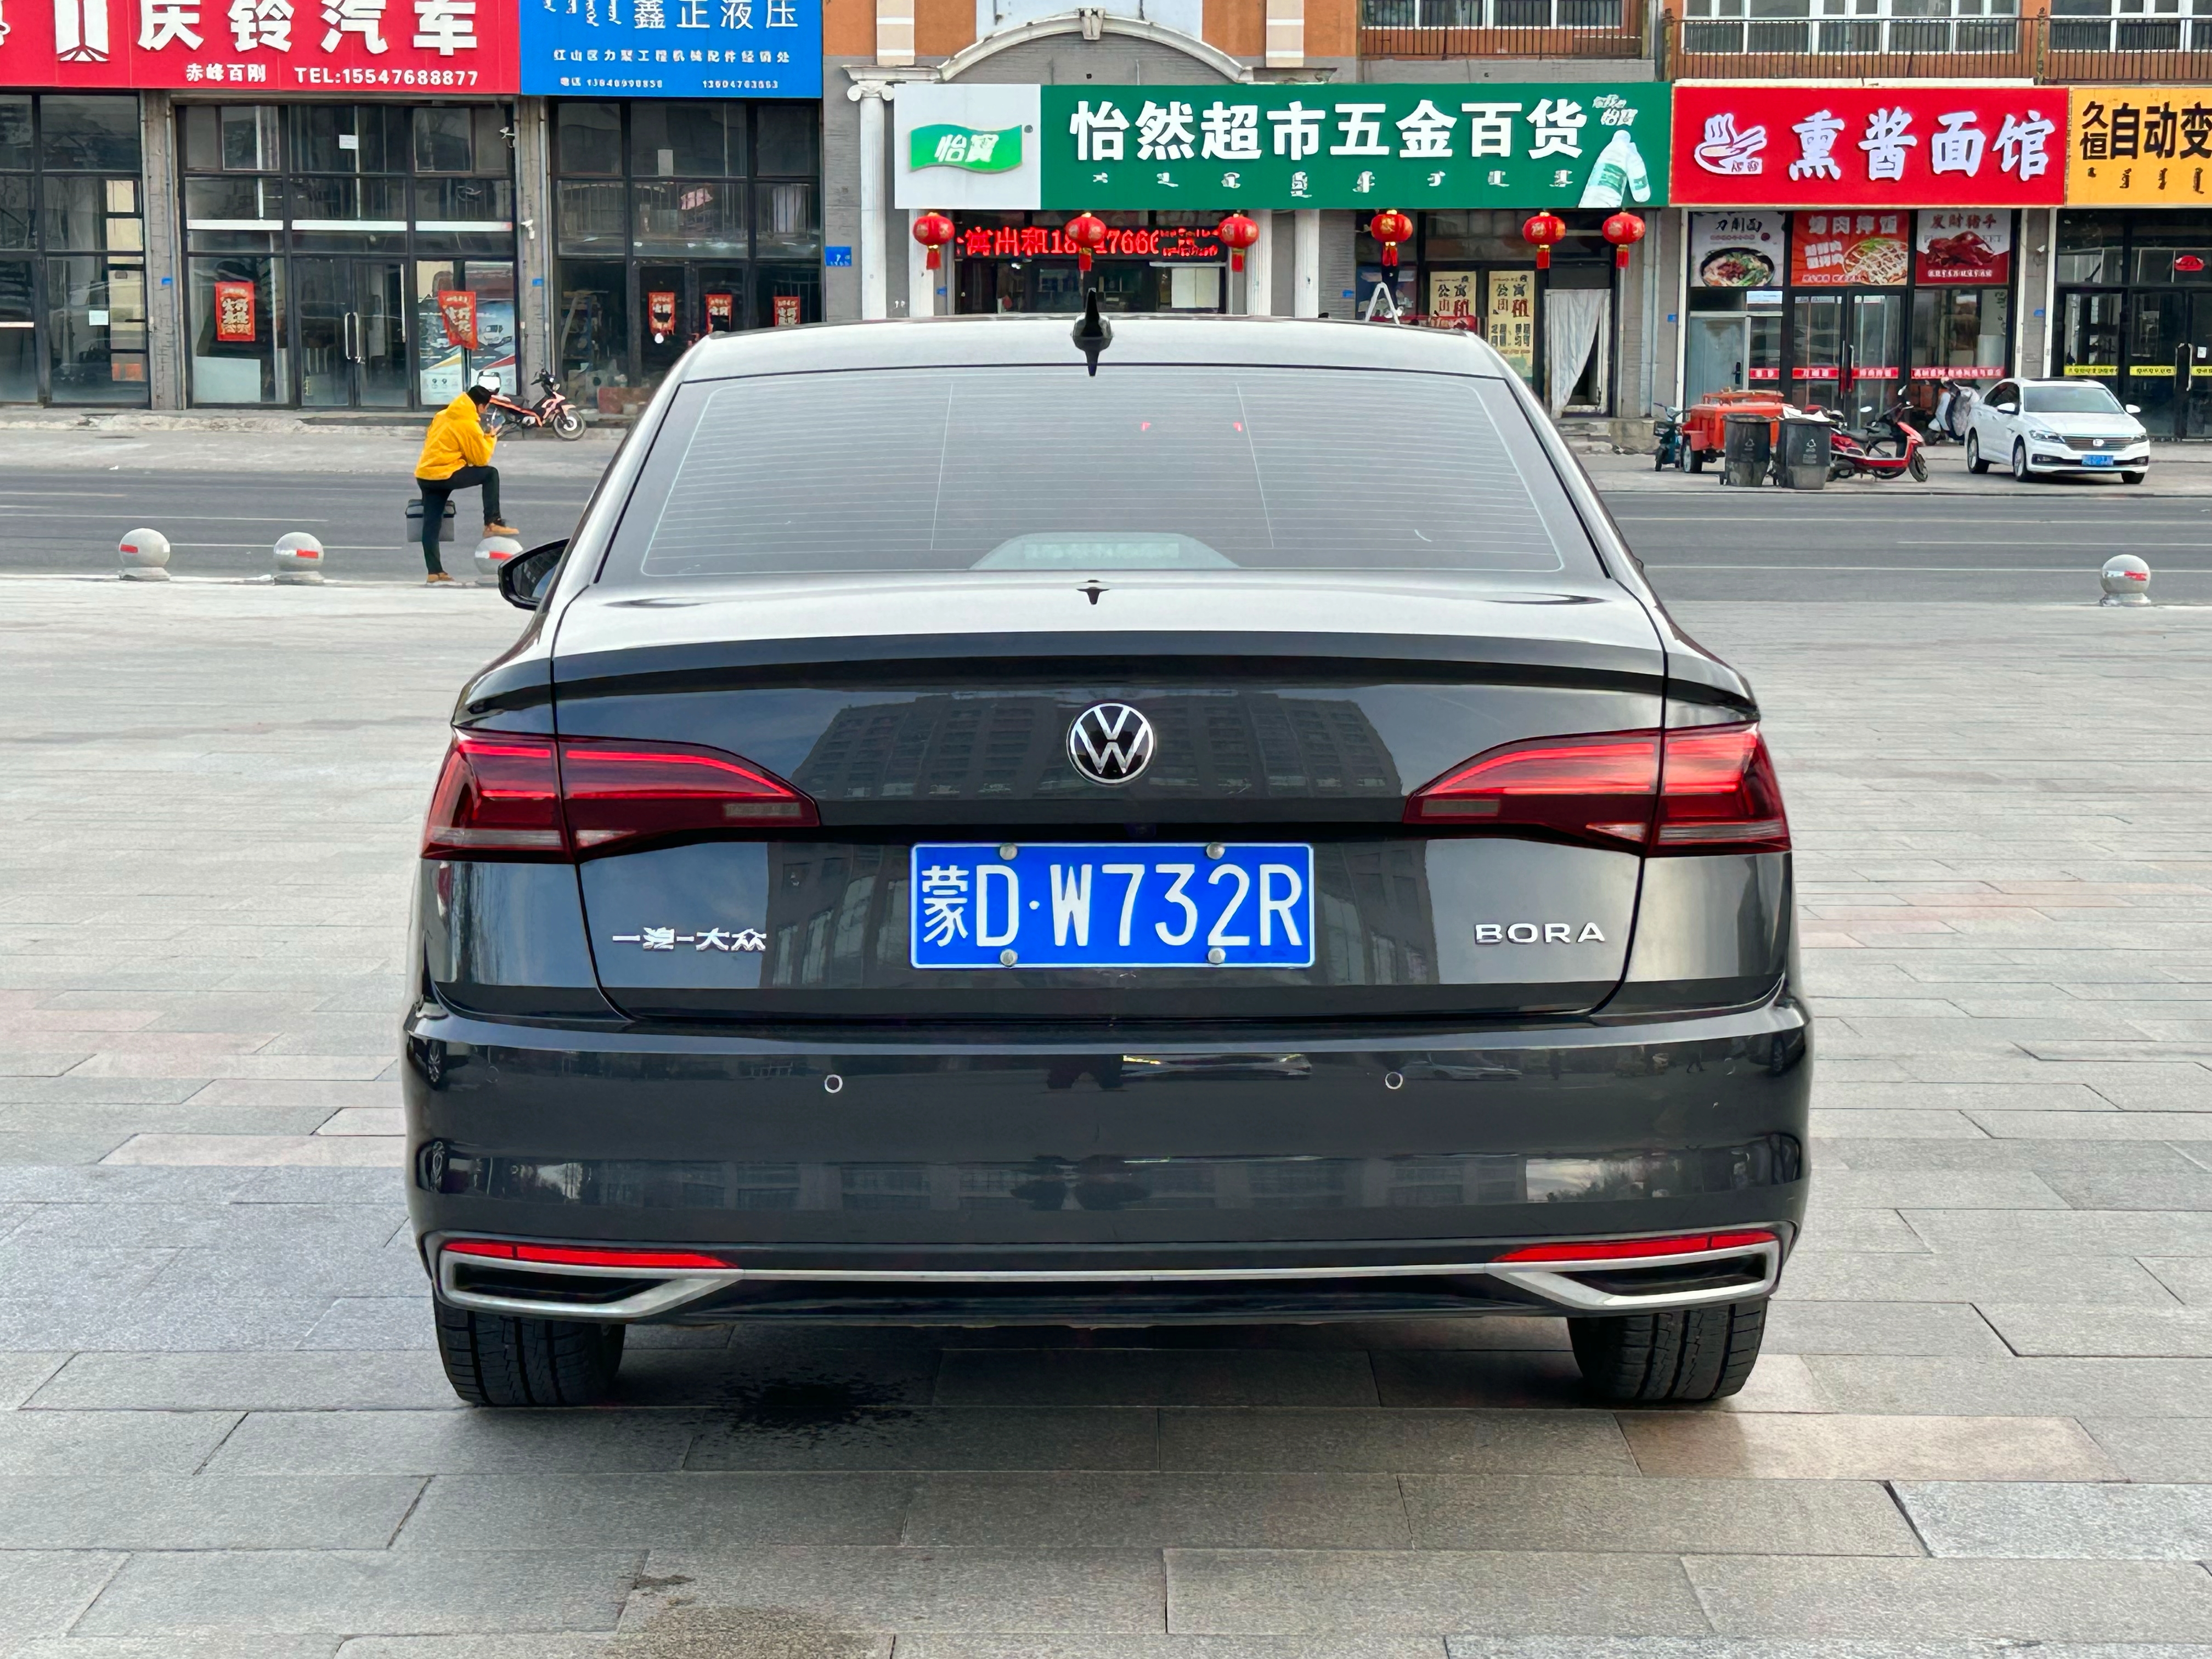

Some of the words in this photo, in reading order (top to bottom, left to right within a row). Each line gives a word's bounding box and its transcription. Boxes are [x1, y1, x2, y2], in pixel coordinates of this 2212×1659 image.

[137, 0, 478, 56] 庆铃汽车
[186, 63, 267, 83] 赤峰百刚
[294, 67, 478, 86] TEL:15547688877
[1069, 99, 1588, 162] 怡然超市五金百货
[1788, 106, 2056, 182] 熏酱面馆
[1715, 217, 1763, 233] 刀削面
[921, 864, 1303, 947] 蒙D·W732R
[1475, 922, 1605, 944] BORA
